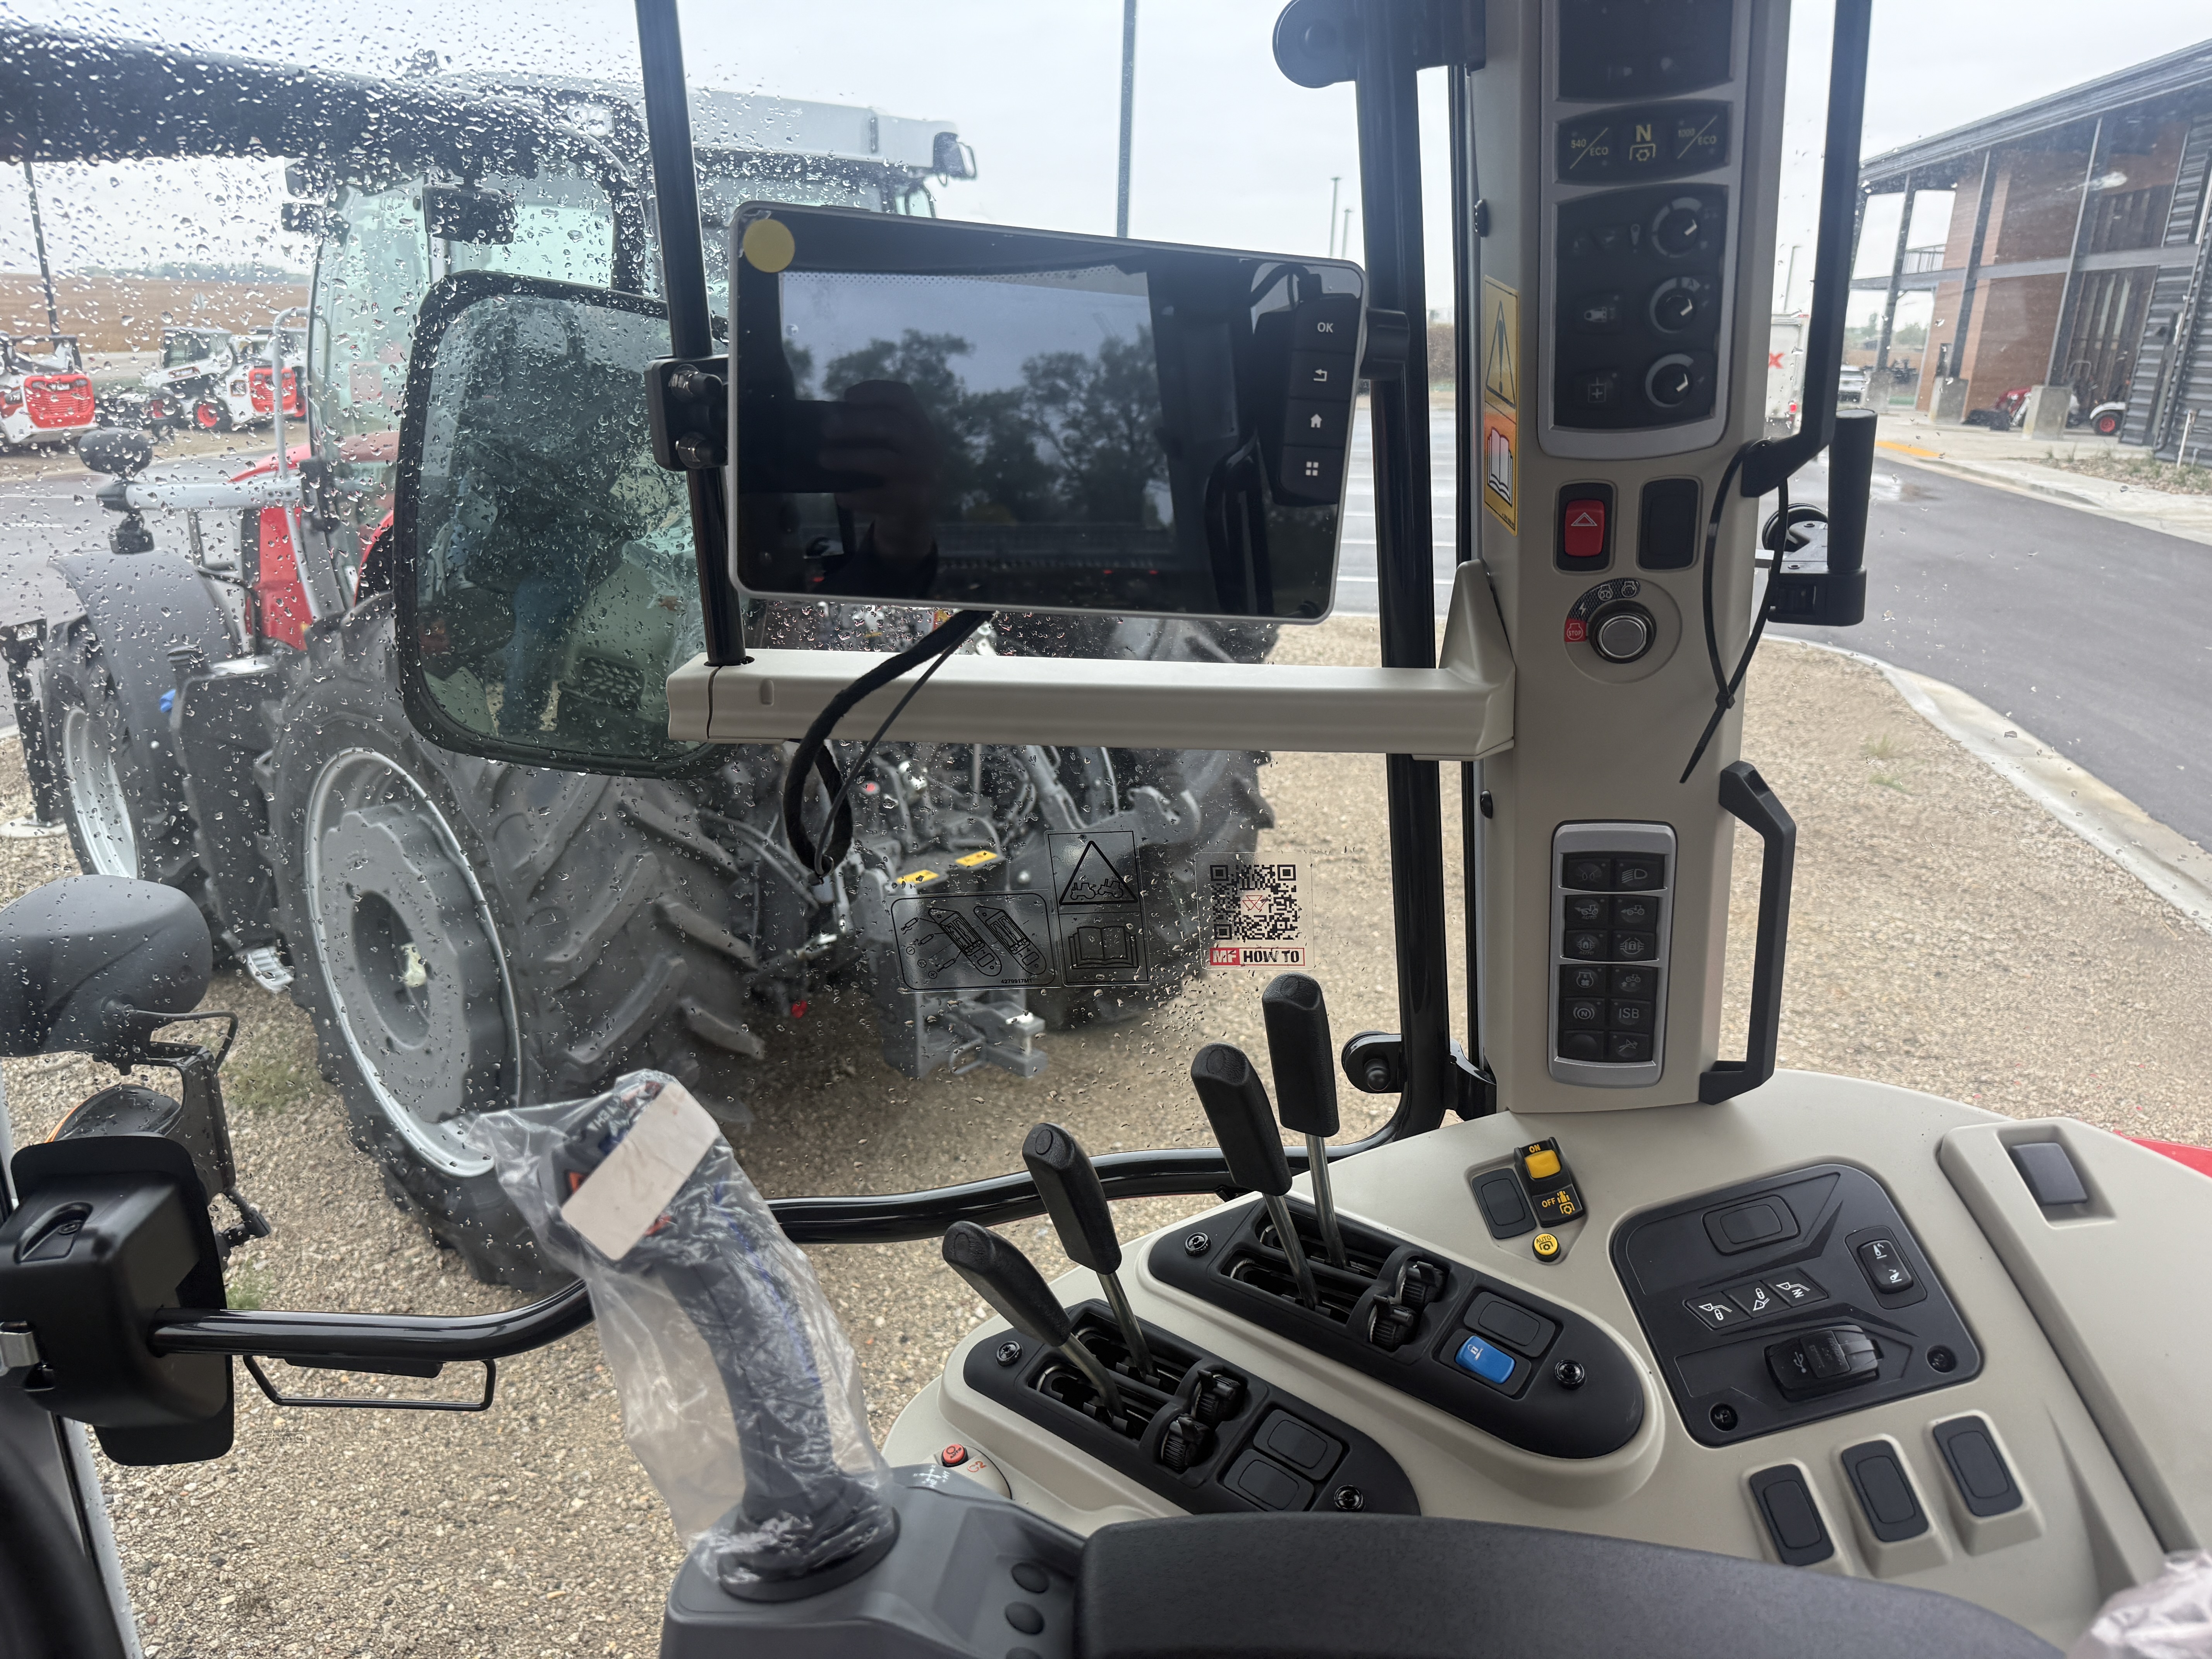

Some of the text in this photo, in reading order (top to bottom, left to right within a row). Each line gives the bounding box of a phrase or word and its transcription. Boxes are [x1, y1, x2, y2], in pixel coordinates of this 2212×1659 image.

[1635, 124, 1651, 142] N
[1571, 139, 1586, 148] 540
[1698, 135, 1717, 146] ECO
[1590, 147, 1608, 156] ECO
[1317, 322, 1333, 333] OK
[1212, 950, 1300, 963] MF HOW TO
[1619, 1008, 1640, 1018] ISB
[1528, 1144, 1541, 1153] ON
[1541, 1197, 1556, 1208] OFF
[1535, 1235, 1552, 1244] AUTO
